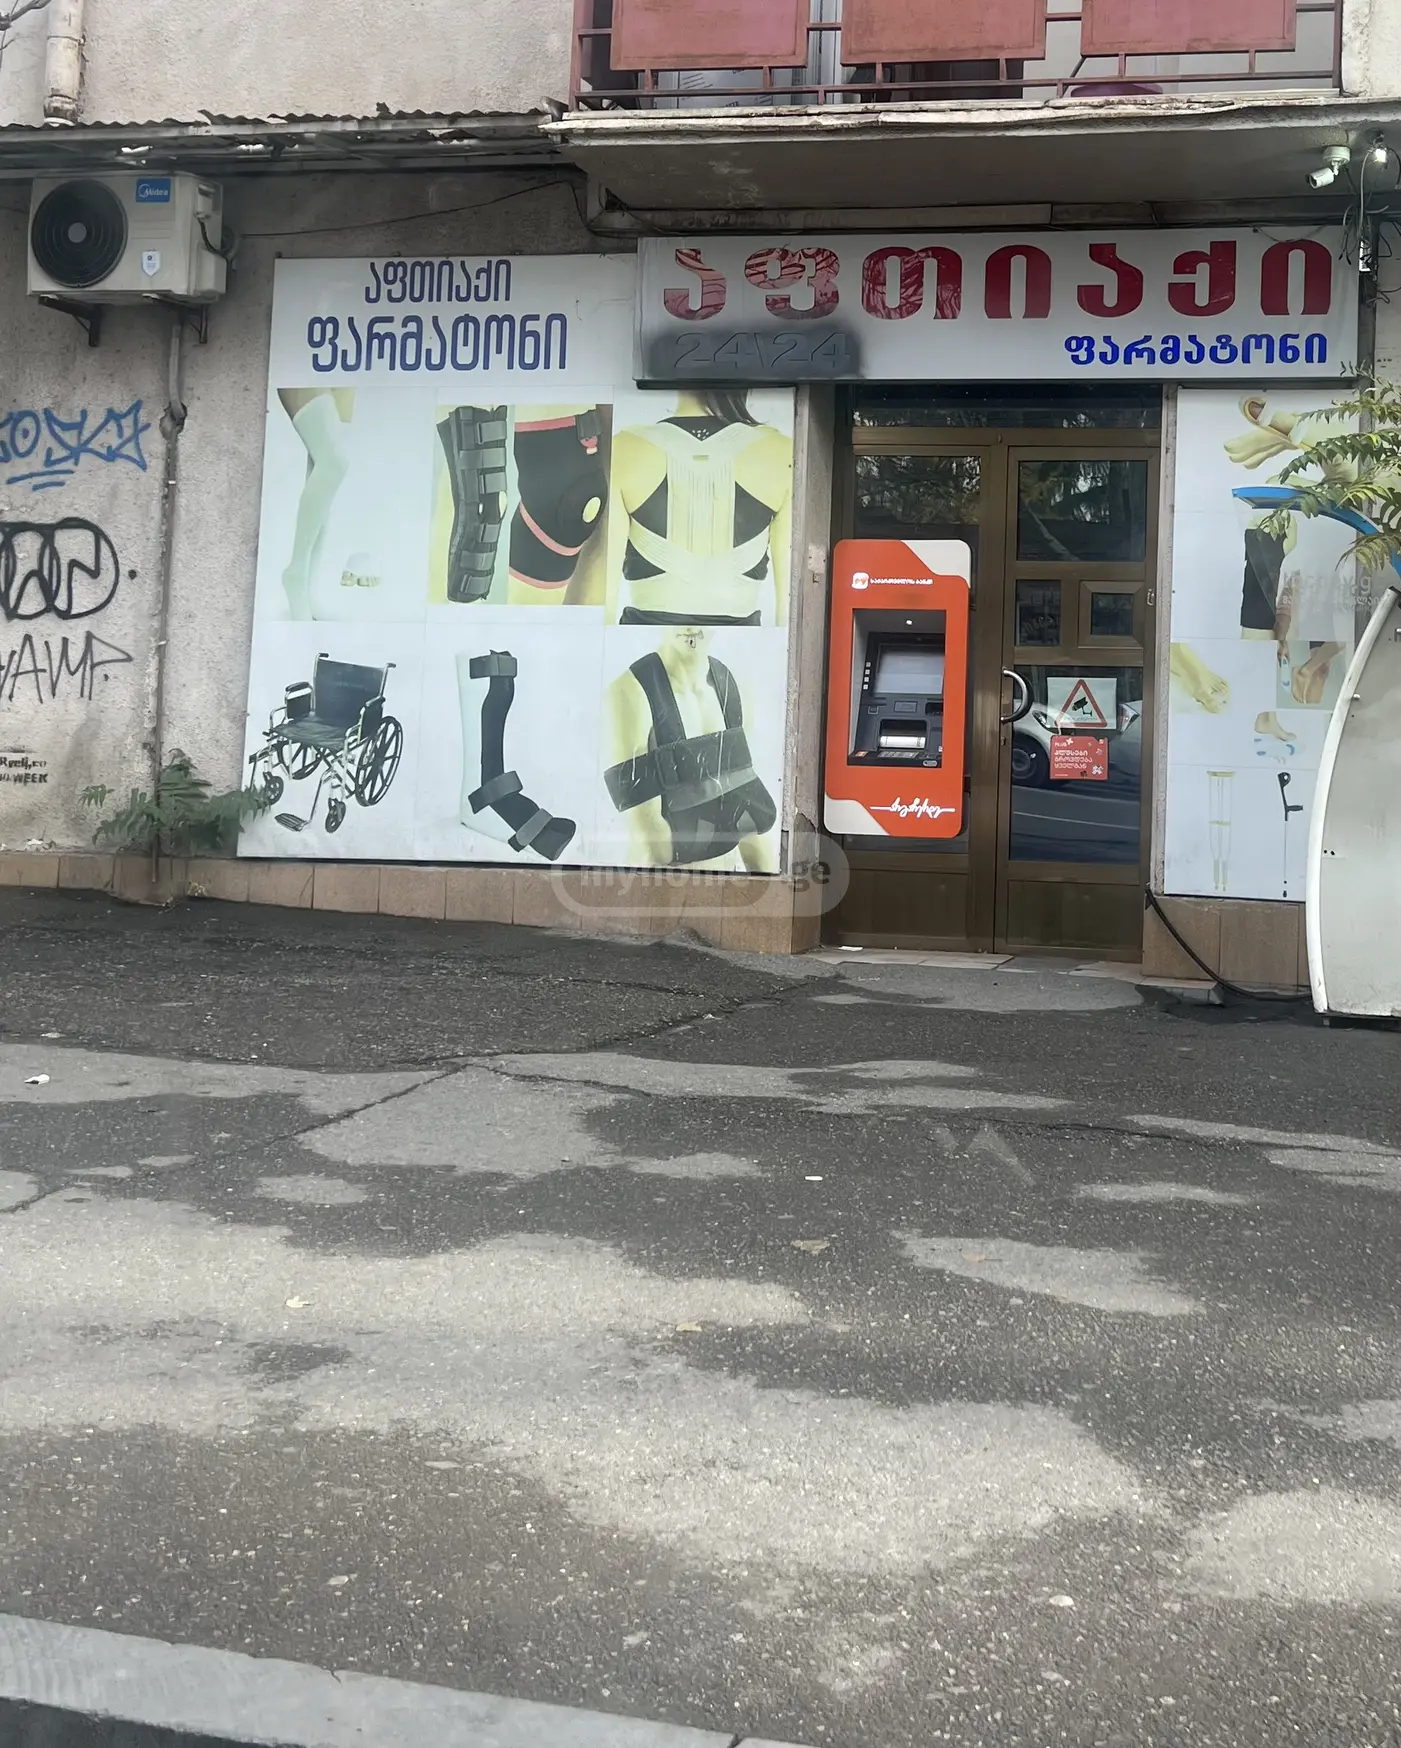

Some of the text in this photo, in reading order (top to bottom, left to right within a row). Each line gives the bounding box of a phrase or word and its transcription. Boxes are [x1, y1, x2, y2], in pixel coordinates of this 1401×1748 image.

[365, 258, 511, 304] აფთიაქი
[663, 240, 1331, 321] აფთიაქი
[307, 312, 568, 373] ფარმატონი
[1064, 332, 1328, 366] ფარმატონი
